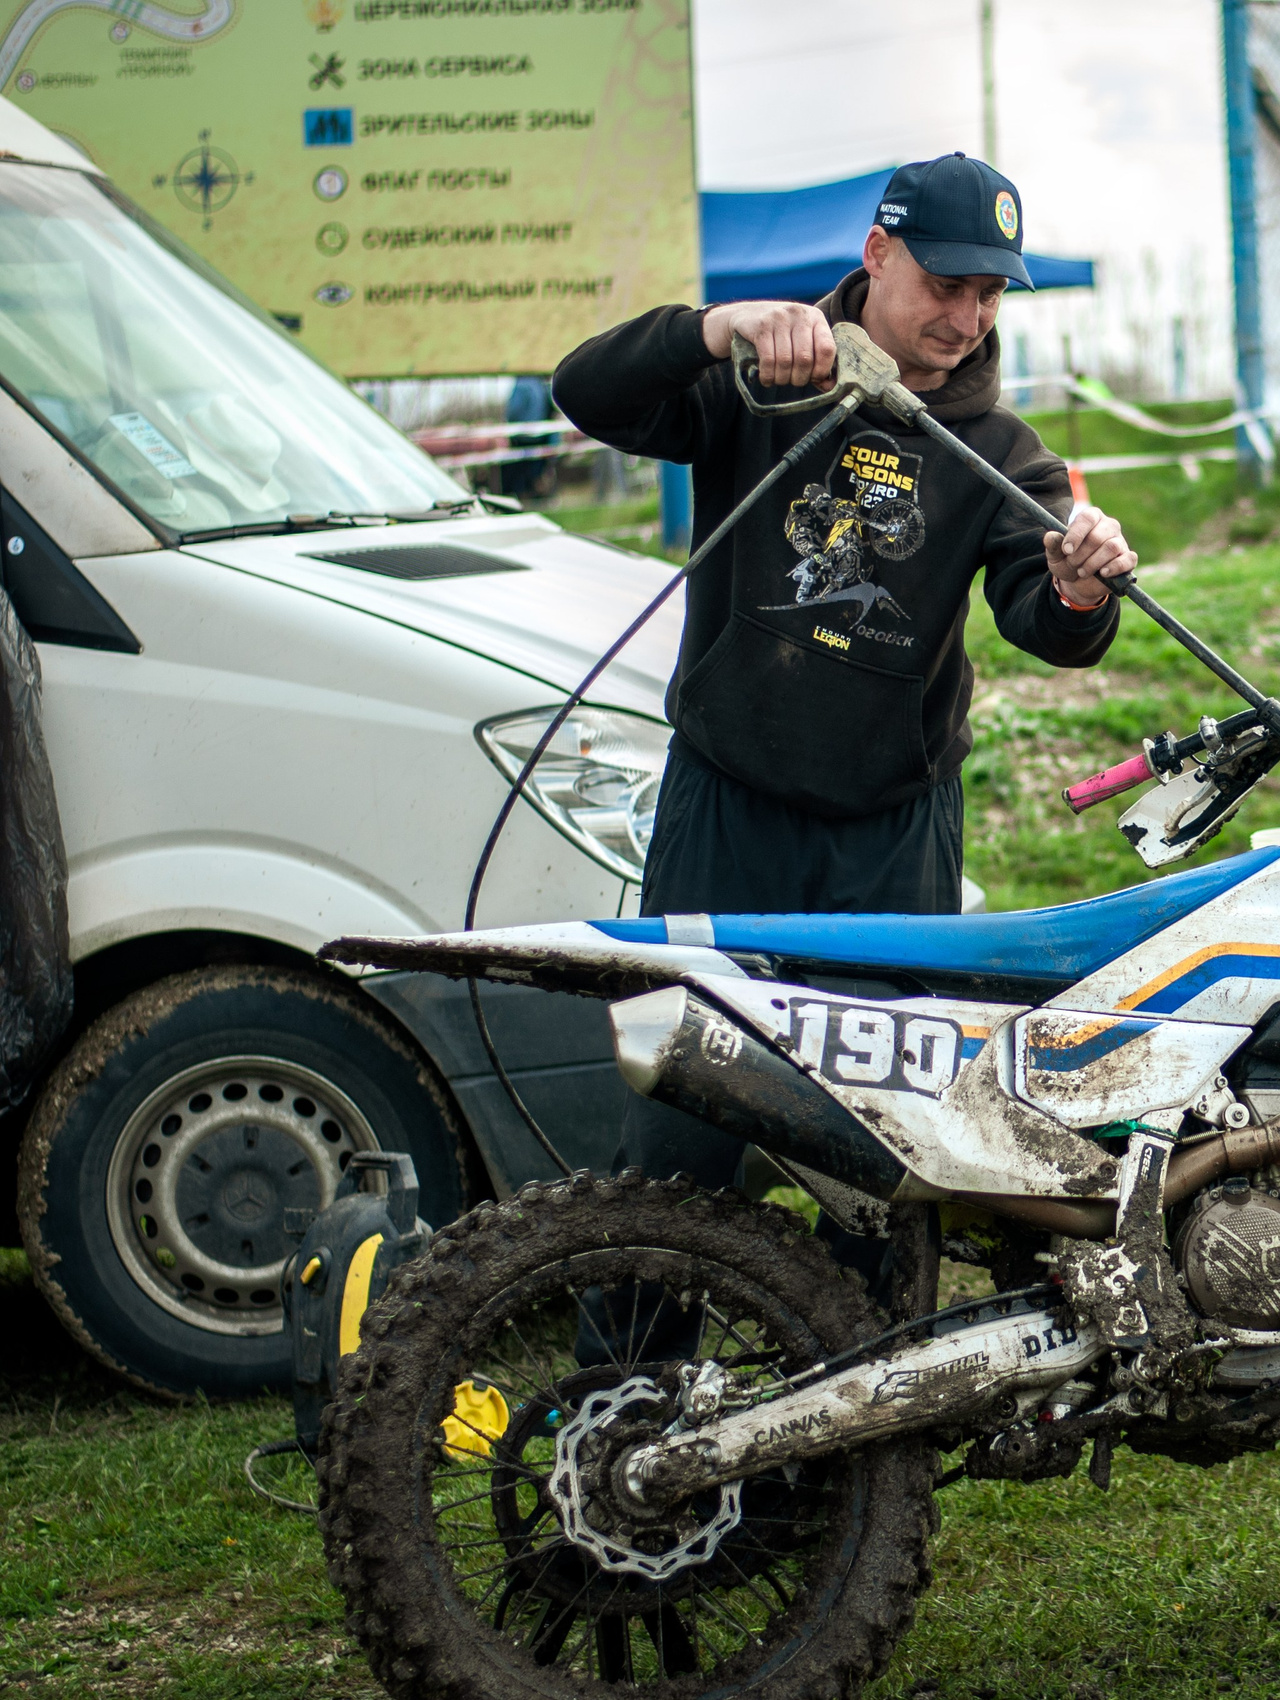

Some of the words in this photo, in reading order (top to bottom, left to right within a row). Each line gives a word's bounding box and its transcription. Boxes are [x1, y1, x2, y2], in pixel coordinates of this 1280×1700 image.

[357, 57, 420, 80] ЗОНА
[424, 54, 535, 78] СЕРВИСА
[358, 110, 521, 137] ЗРИТЕЛЬСКИЕ
[525, 108, 596, 132] ЗОНЫ
[360, 169, 422, 192] ФЛАГ
[427, 167, 511, 191] ПОСТЫ
[880, 203, 908, 216] NATIONAL
[881, 215, 900, 226] TEAM
[361, 224, 496, 251] СУДЕЙСКИЙ
[500, 221, 573, 246] ПУНКТ
[364, 280, 537, 306] КОНТРОЛЬНЫЙ
[541, 275, 614, 300] ПУНКТ
[813, 629, 851, 651] LEGION
[796, 1002, 957, 1092] 190
[754, 1409, 832, 1447] CANVAS
